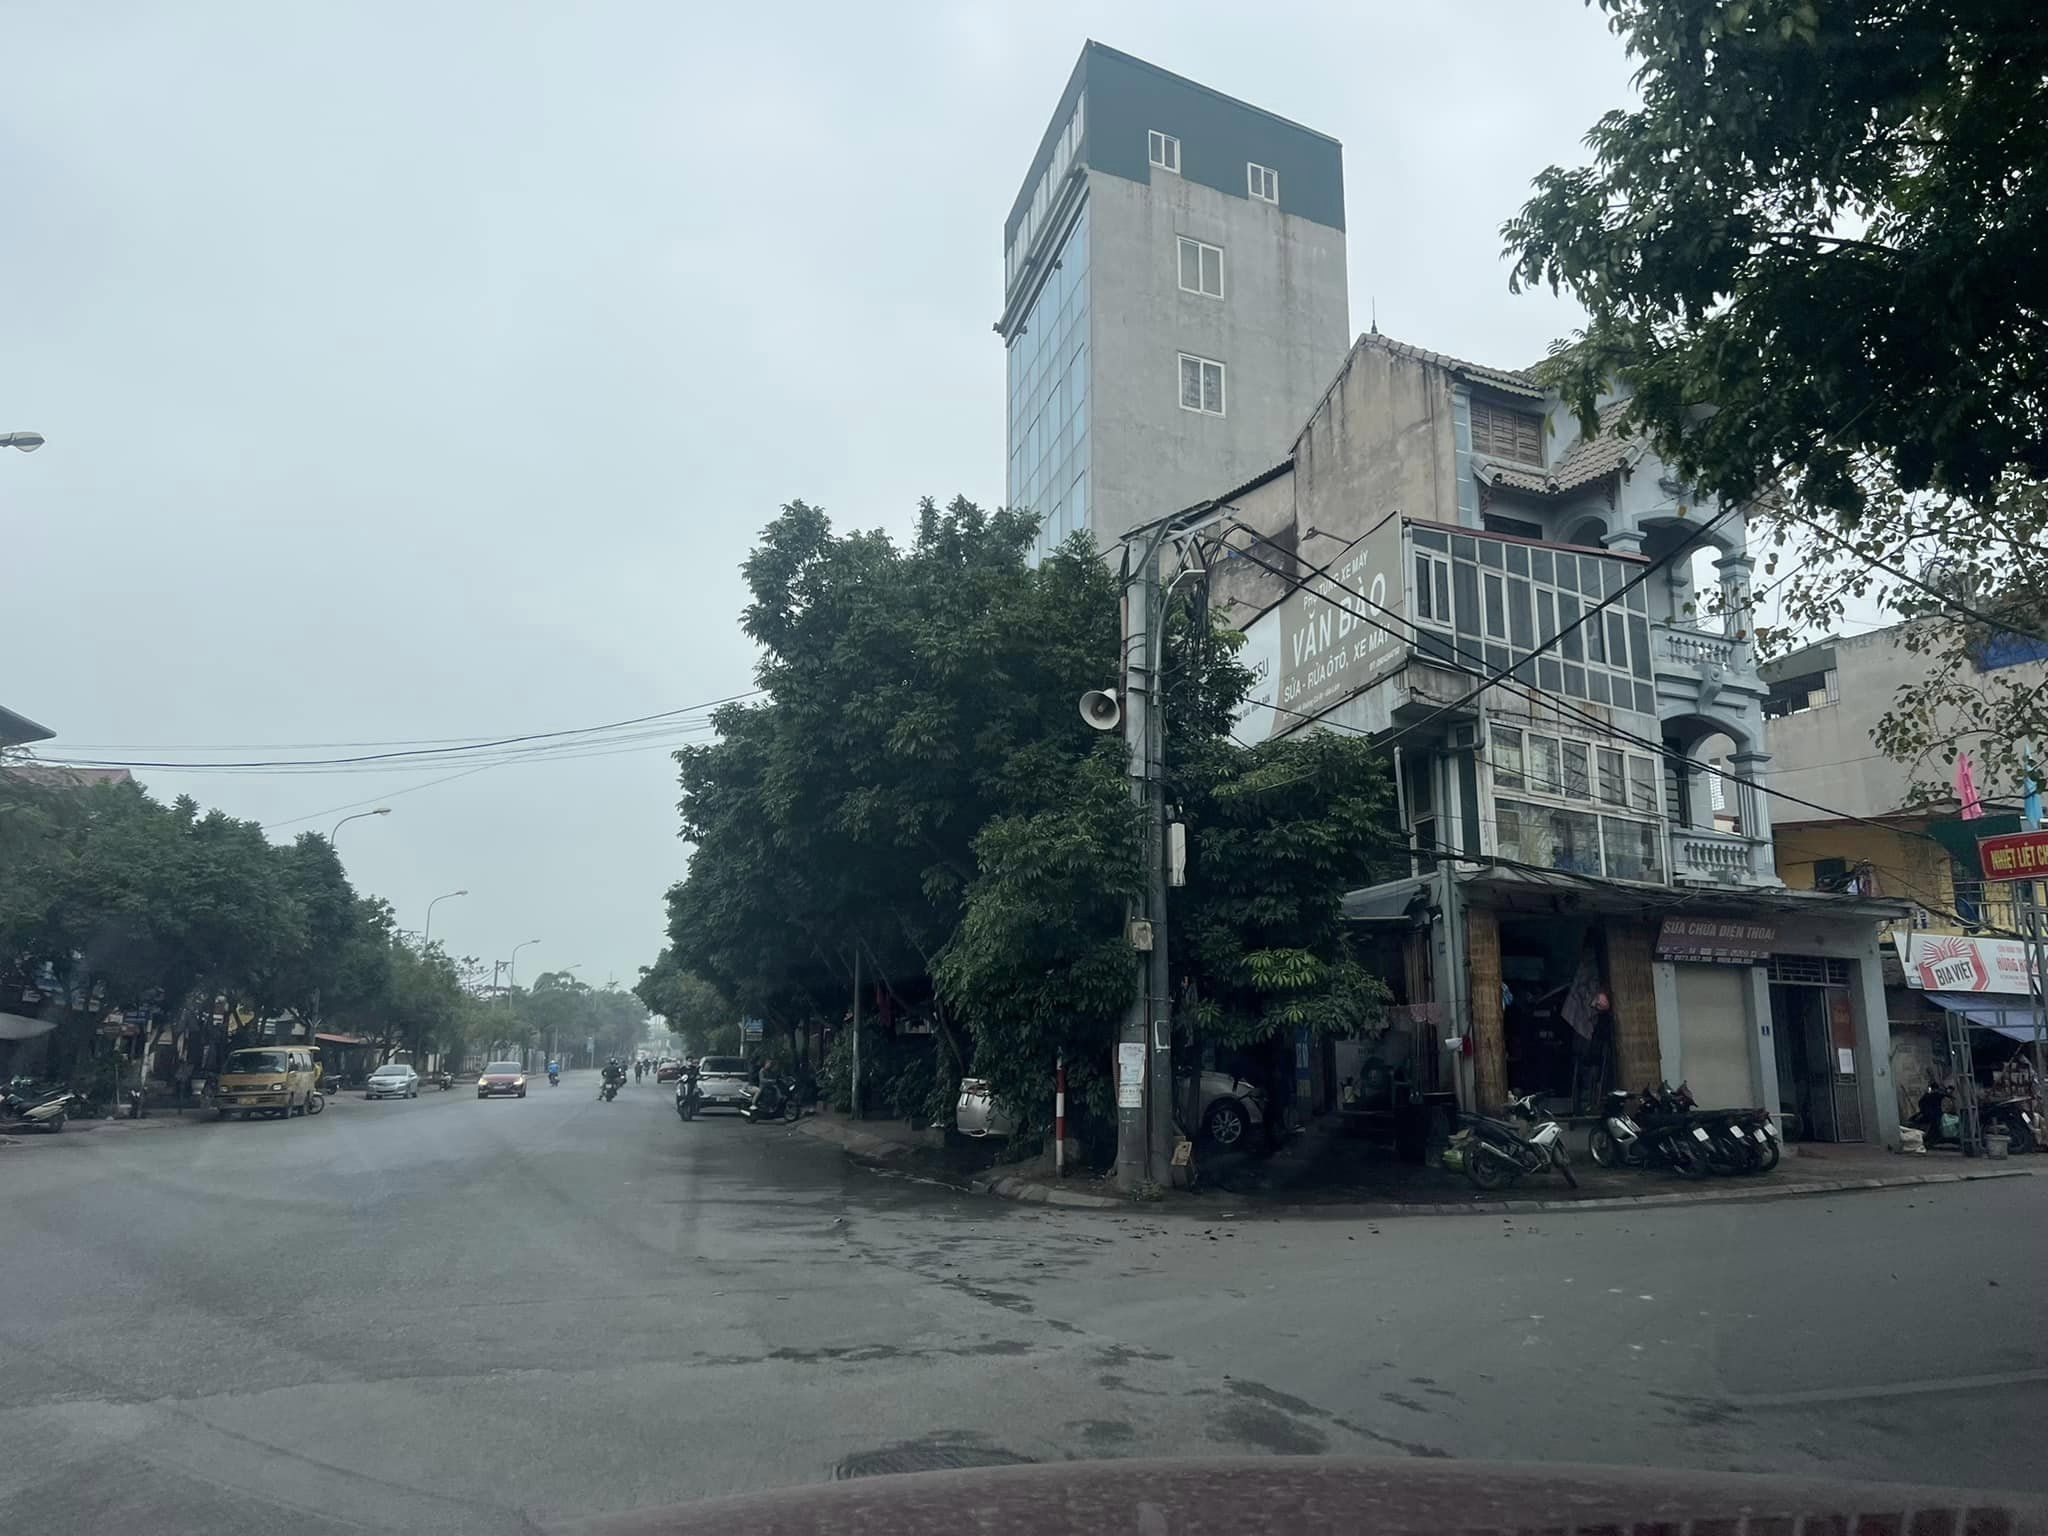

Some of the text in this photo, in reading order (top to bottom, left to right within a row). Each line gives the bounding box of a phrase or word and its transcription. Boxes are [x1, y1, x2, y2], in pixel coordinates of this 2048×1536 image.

[1293, 608, 1332, 668] VĂN
[1284, 676, 1302, 703] SỬA
[1353, 637, 1367, 662] XE
[1663, 918, 1686, 935] SỬA
[1935, 966, 1956, 986] BIA
[1950, 959, 1974, 982] VIỆT
